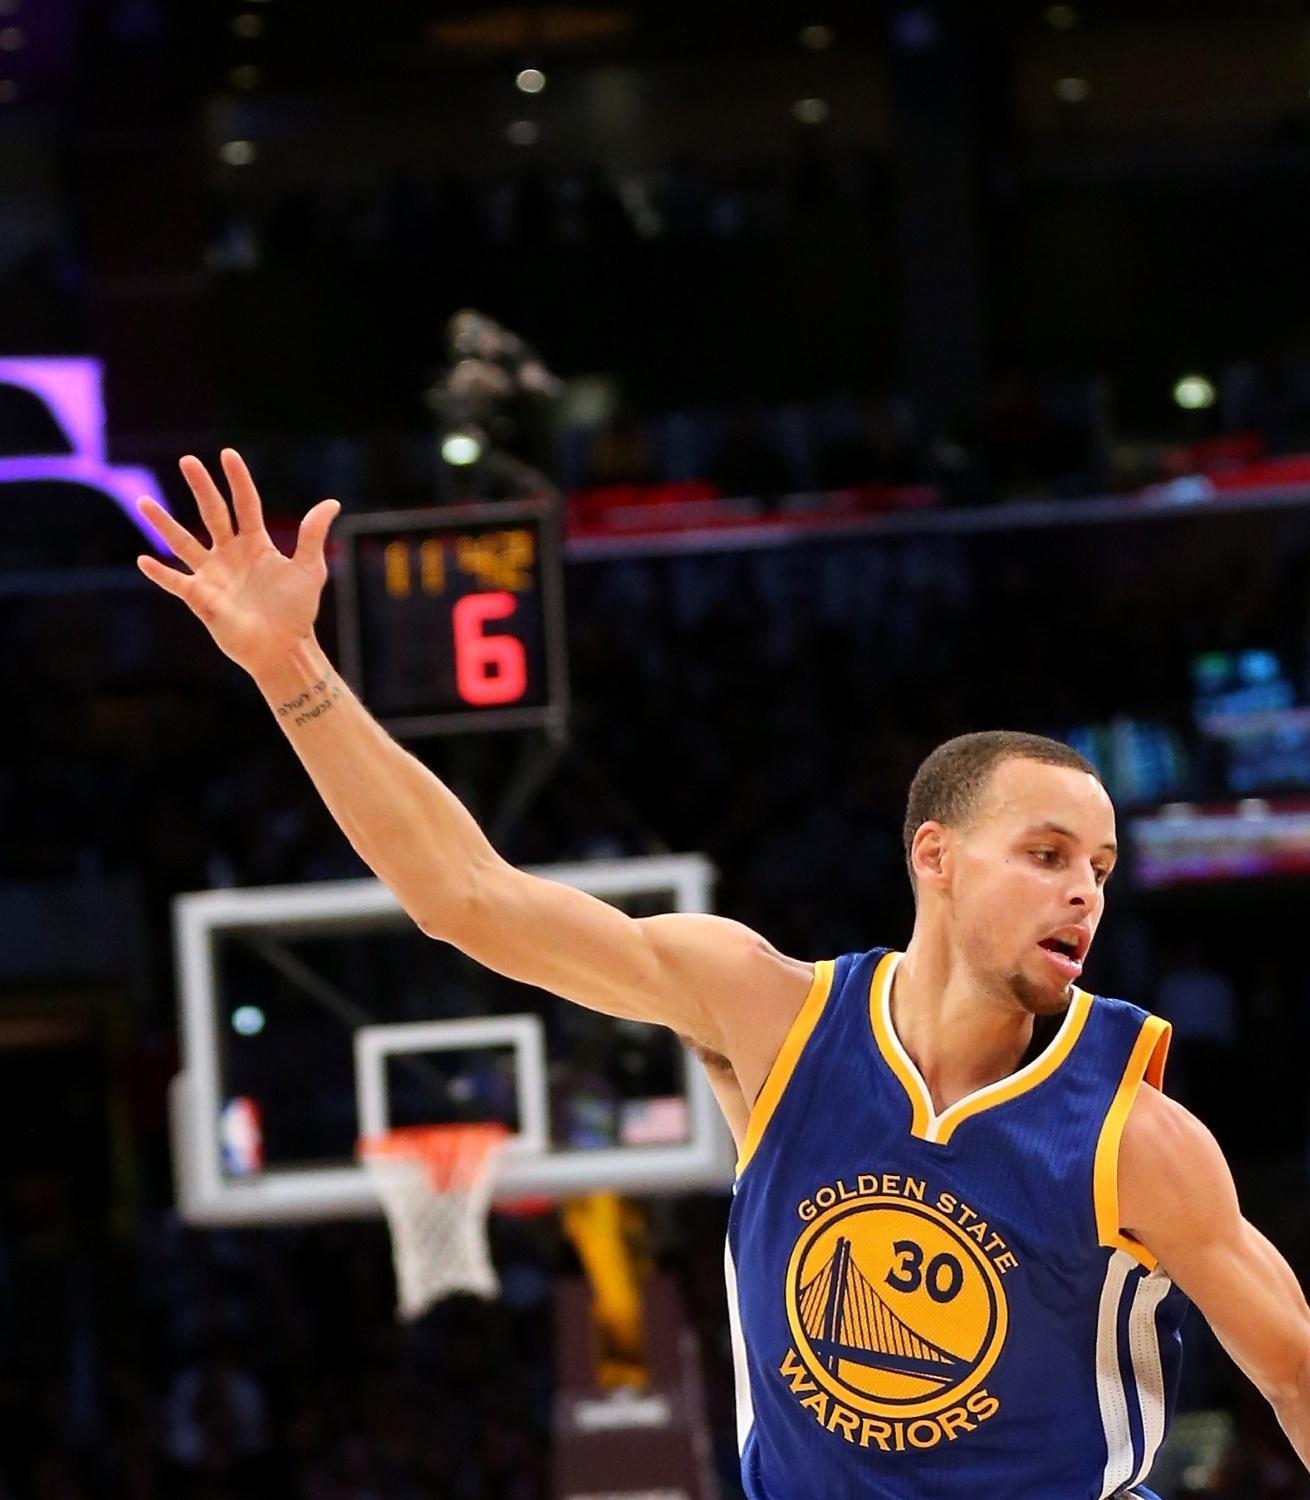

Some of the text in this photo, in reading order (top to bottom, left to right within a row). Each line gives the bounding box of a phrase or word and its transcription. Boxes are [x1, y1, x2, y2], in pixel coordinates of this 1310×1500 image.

[453, 590, 527, 708] 6
[797, 1174, 1019, 1275] GOLDEN STATE
[884, 1240, 964, 1304] 30
[778, 1347, 1001, 1452] WARRIORS
